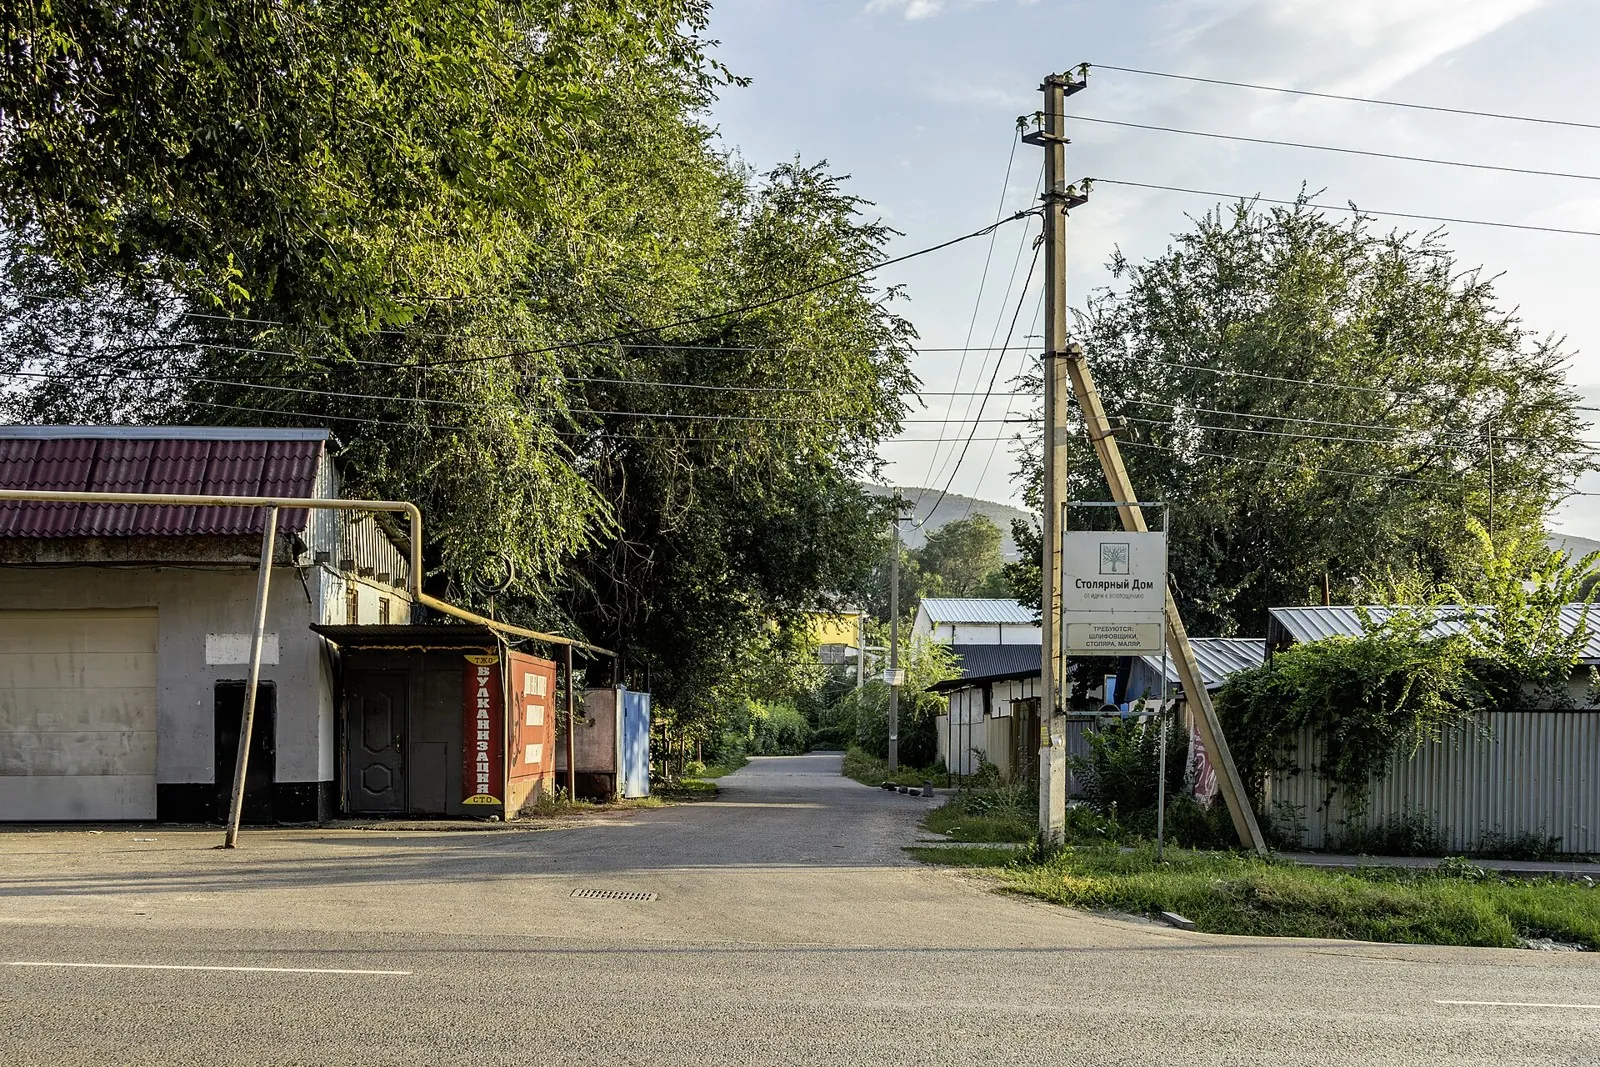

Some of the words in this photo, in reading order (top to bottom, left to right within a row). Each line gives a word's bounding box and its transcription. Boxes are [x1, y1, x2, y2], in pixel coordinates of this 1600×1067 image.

[1075, 578, 1130, 591] Столярный
[1132, 578, 1154, 591] Дом
[476, 666, 490, 794] ВУЛКАНИЗАЦИЯ
